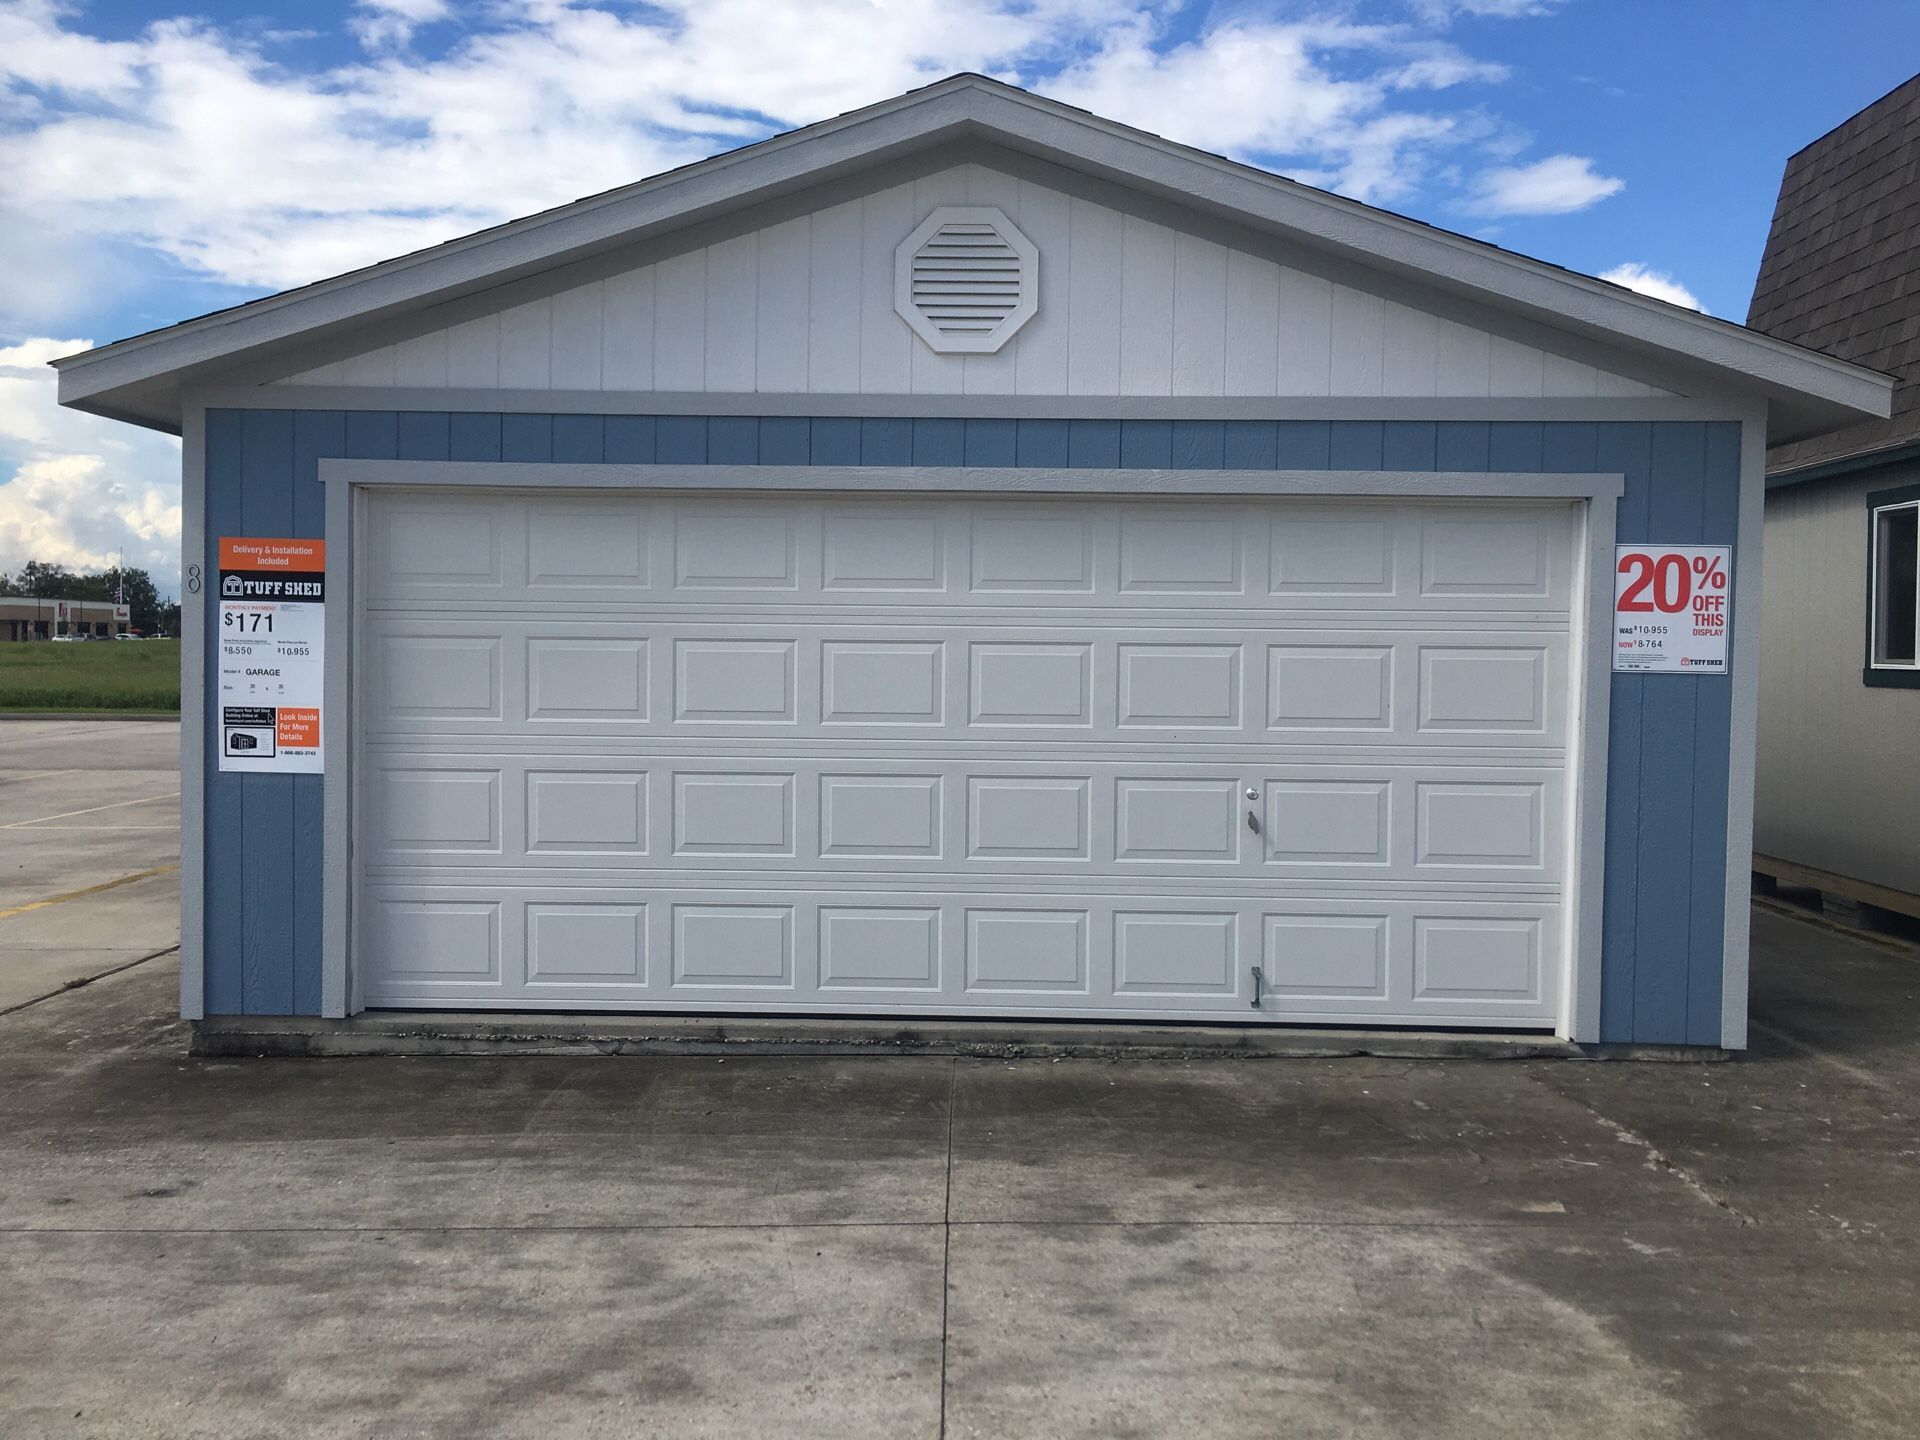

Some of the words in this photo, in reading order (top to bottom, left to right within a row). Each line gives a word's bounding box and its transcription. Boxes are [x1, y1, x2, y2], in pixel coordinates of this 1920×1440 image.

[233, 545, 262, 555] Delivery
[265, 546, 270, 554] &
[272, 546, 313, 555] Installation
[258, 557, 288, 566] Included
[188, 564, 201, 593] 8
[1616, 553, 1726, 614] 20%
[244, 581, 282, 595] TUFF
[284, 582, 322, 596] SHED
[1692, 595, 1724, 612] OFF
[225, 612, 273, 632] $171
[1692, 613, 1724, 627] THIS
[1692, 628, 1724, 636] DISPLAY
[246, 668, 280, 676] GARAGE
